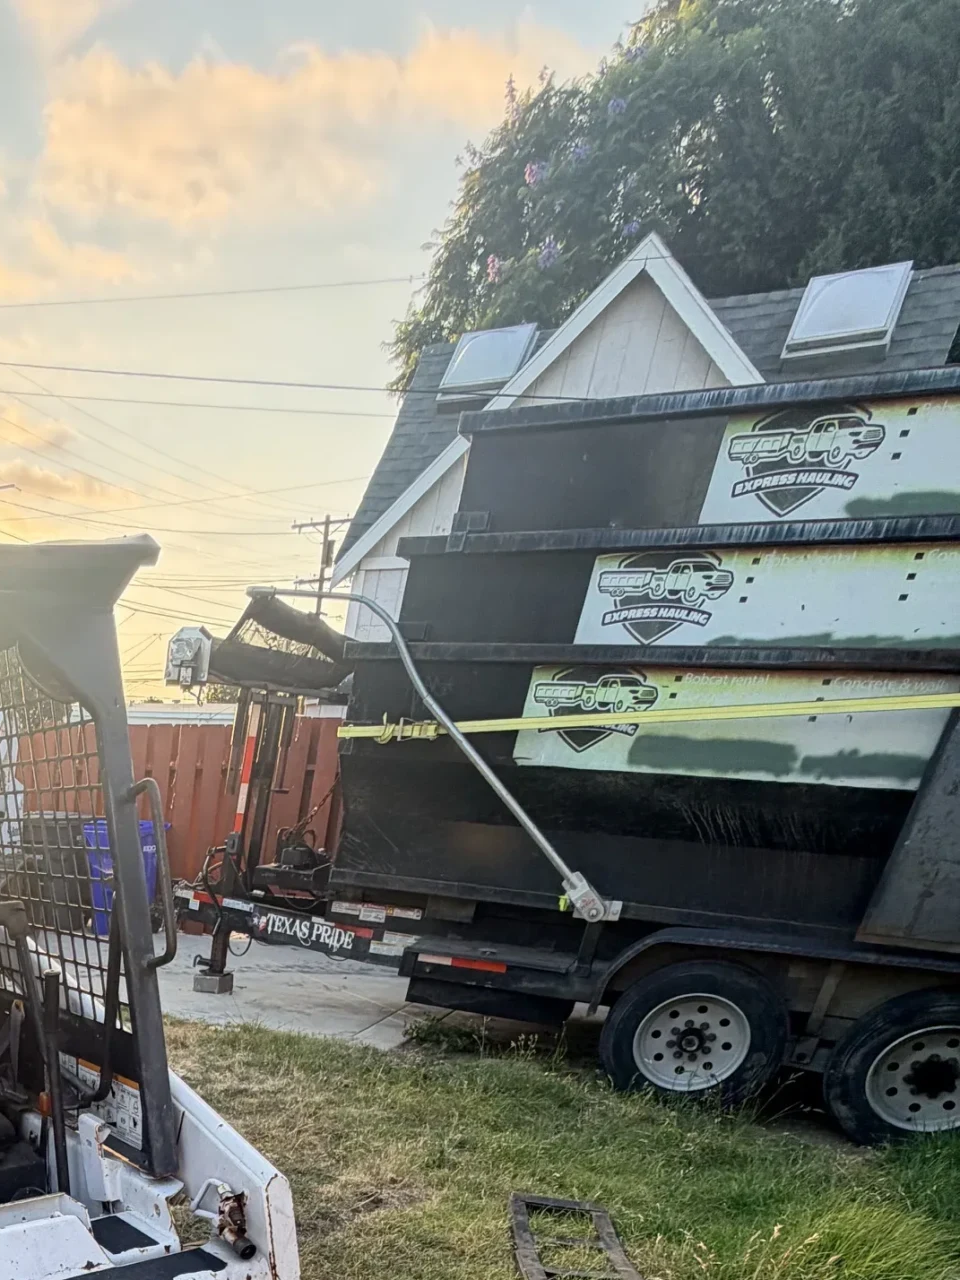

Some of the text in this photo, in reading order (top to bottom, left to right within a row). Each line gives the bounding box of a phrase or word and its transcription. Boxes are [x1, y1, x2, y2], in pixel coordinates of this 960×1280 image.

[734, 472, 856, 495] EXPRESS HAULING
[603, 607, 710, 626] EXPRESS HAULING
[685, 672, 771, 688] Bobcat rental
[834, 677, 897, 692] Concrete
[266, 913, 311, 946] TEXAS
[311, 923, 355, 952] PRIDE
